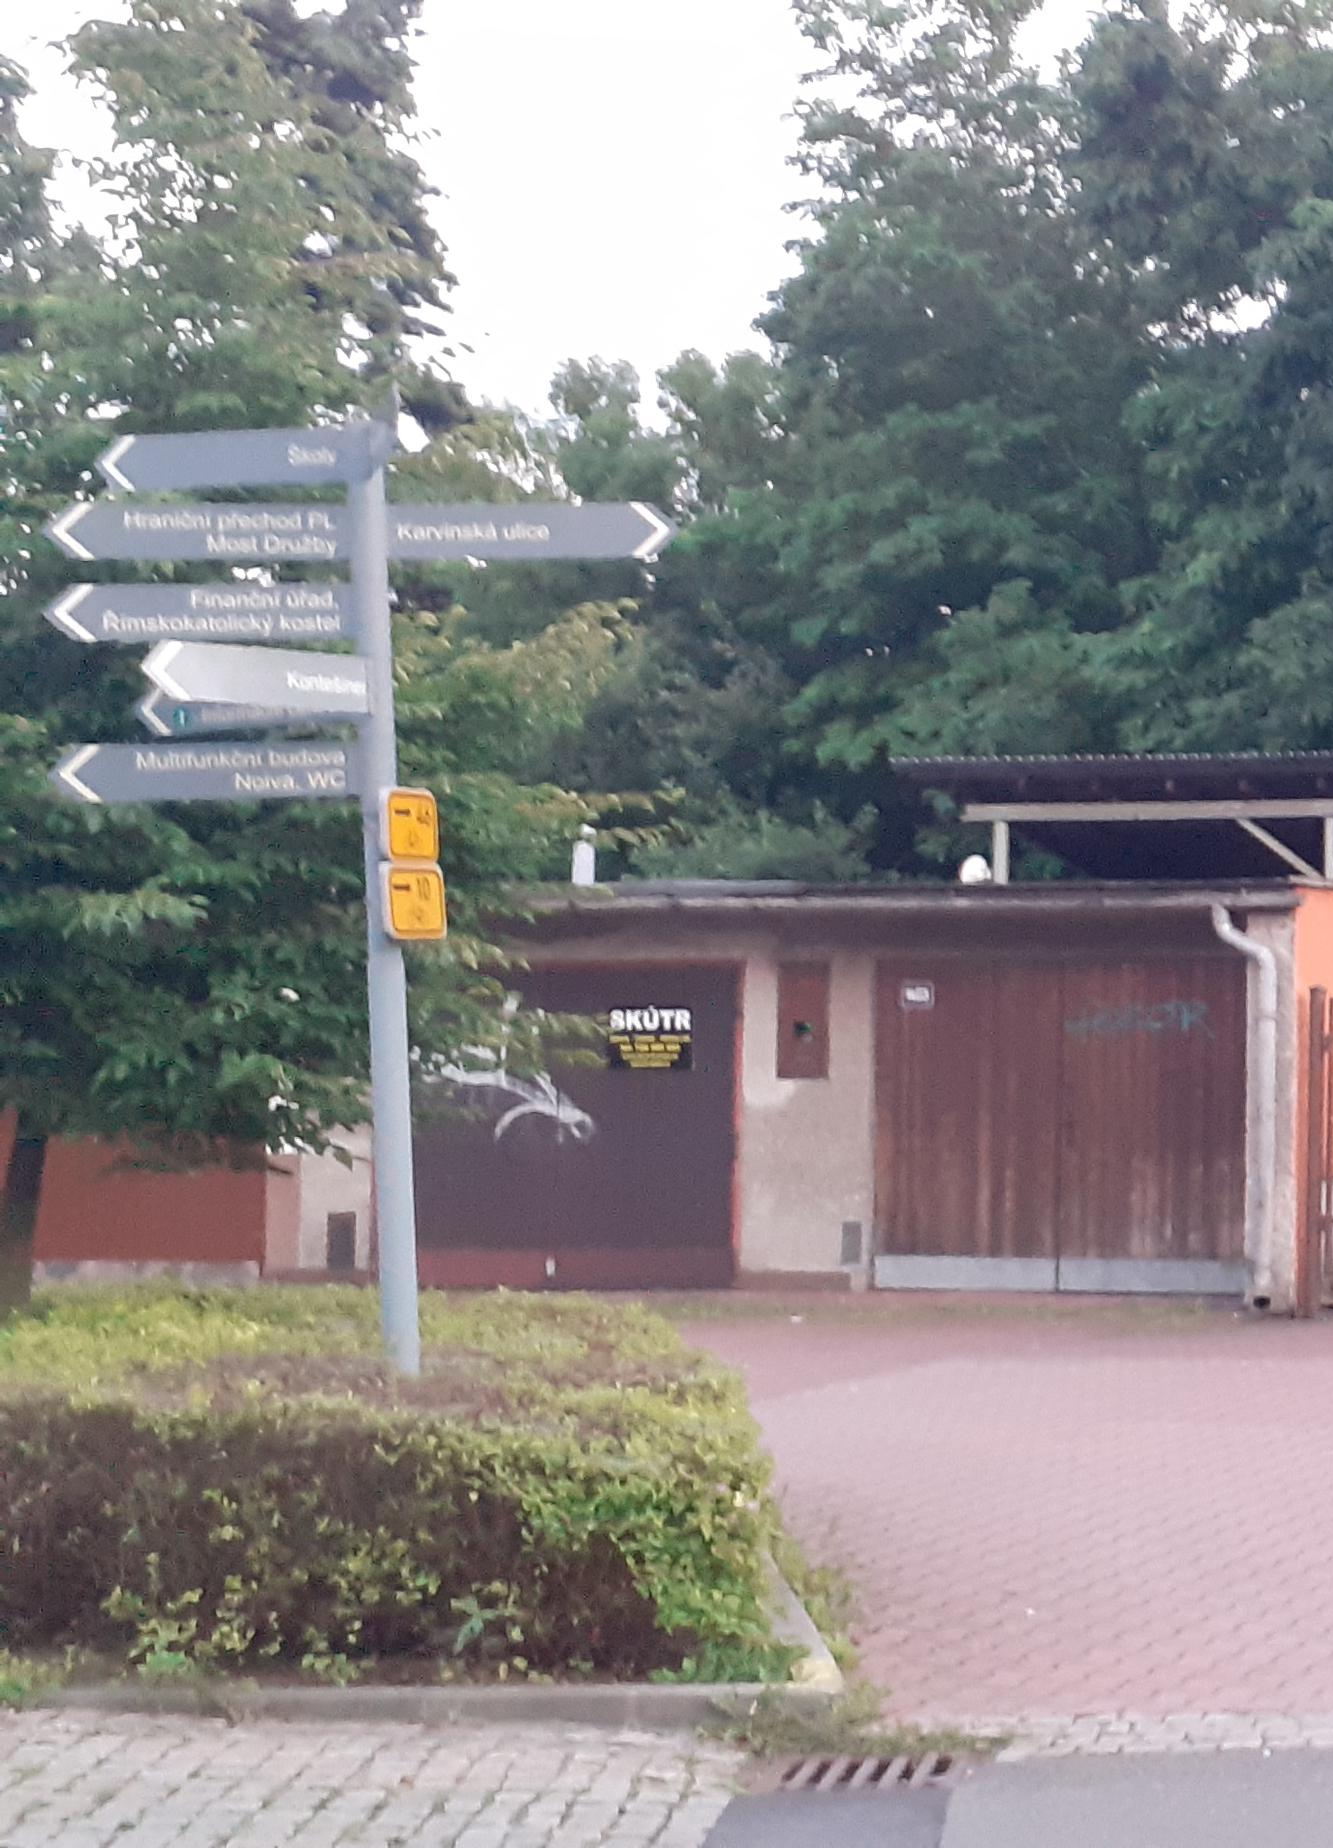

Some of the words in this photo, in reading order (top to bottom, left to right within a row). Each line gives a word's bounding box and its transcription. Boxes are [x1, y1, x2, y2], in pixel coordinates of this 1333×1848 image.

[123, 510, 211, 530] Hraniční
[217, 511, 302, 532] přechod
[397, 521, 498, 541] Karvinská
[503, 522, 550, 541] ulice
[206, 533, 258, 554] Most
[264, 534, 337, 558] Družby
[190, 589, 280, 609] Finanční
[103, 609, 273, 636] Římskokatolický
[279, 614, 341, 632] kostel
[136, 751, 262, 770] Multifunkční
[269, 749, 346, 767] budova
[306, 769, 346, 788] WC
[609, 1004, 692, 1032] SKÚTR
